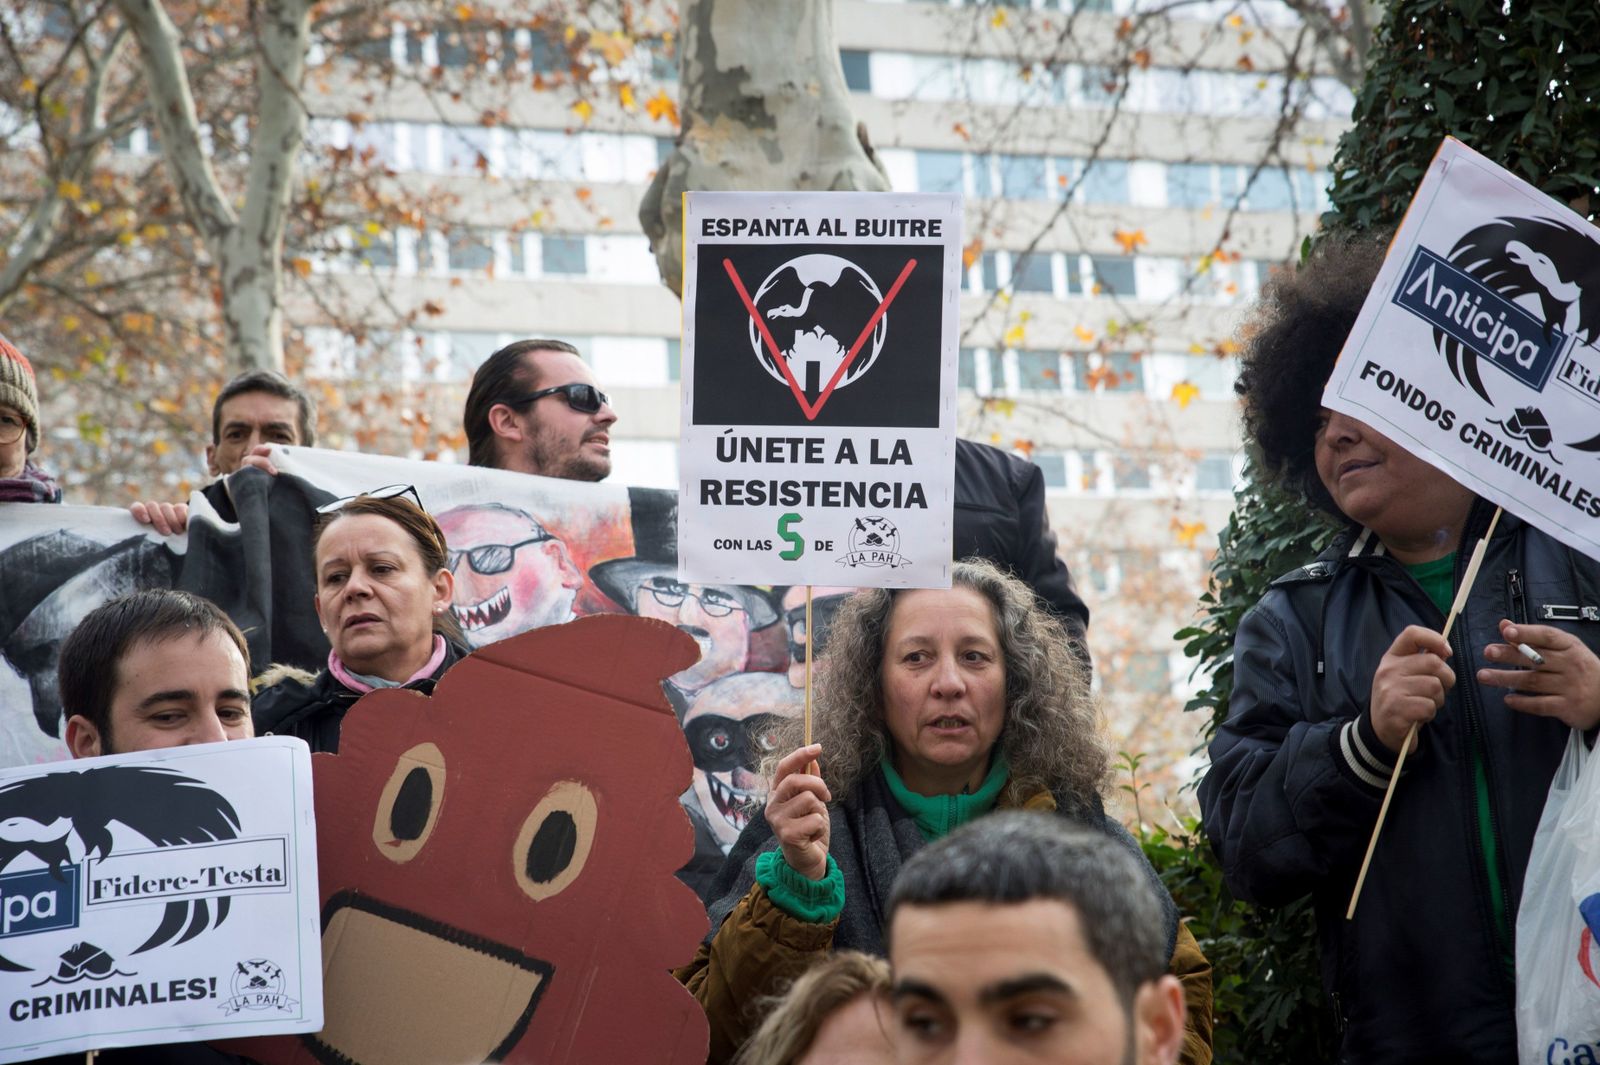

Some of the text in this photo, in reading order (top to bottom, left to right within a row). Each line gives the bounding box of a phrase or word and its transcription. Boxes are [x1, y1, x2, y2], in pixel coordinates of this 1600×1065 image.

[701, 218, 943, 238] ESPANTA AL BUITRE
[1406, 262, 1540, 370] Anticipa
[716, 428, 913, 466] ÚNETE A LA
[1359, 359, 1600, 518] FONDOS CRIMINALES
[700, 479, 929, 509] RESISTENCIA
[713, 512, 834, 561] CON LAS S DE
[851, 551, 894, 564] LA PAH
[91, 863, 283, 900] Fidere-Testa
[0, 887, 57, 934] pa
[8, 976, 217, 1022] CRIMINALES!
[234, 994, 280, 1008] LA PAH
